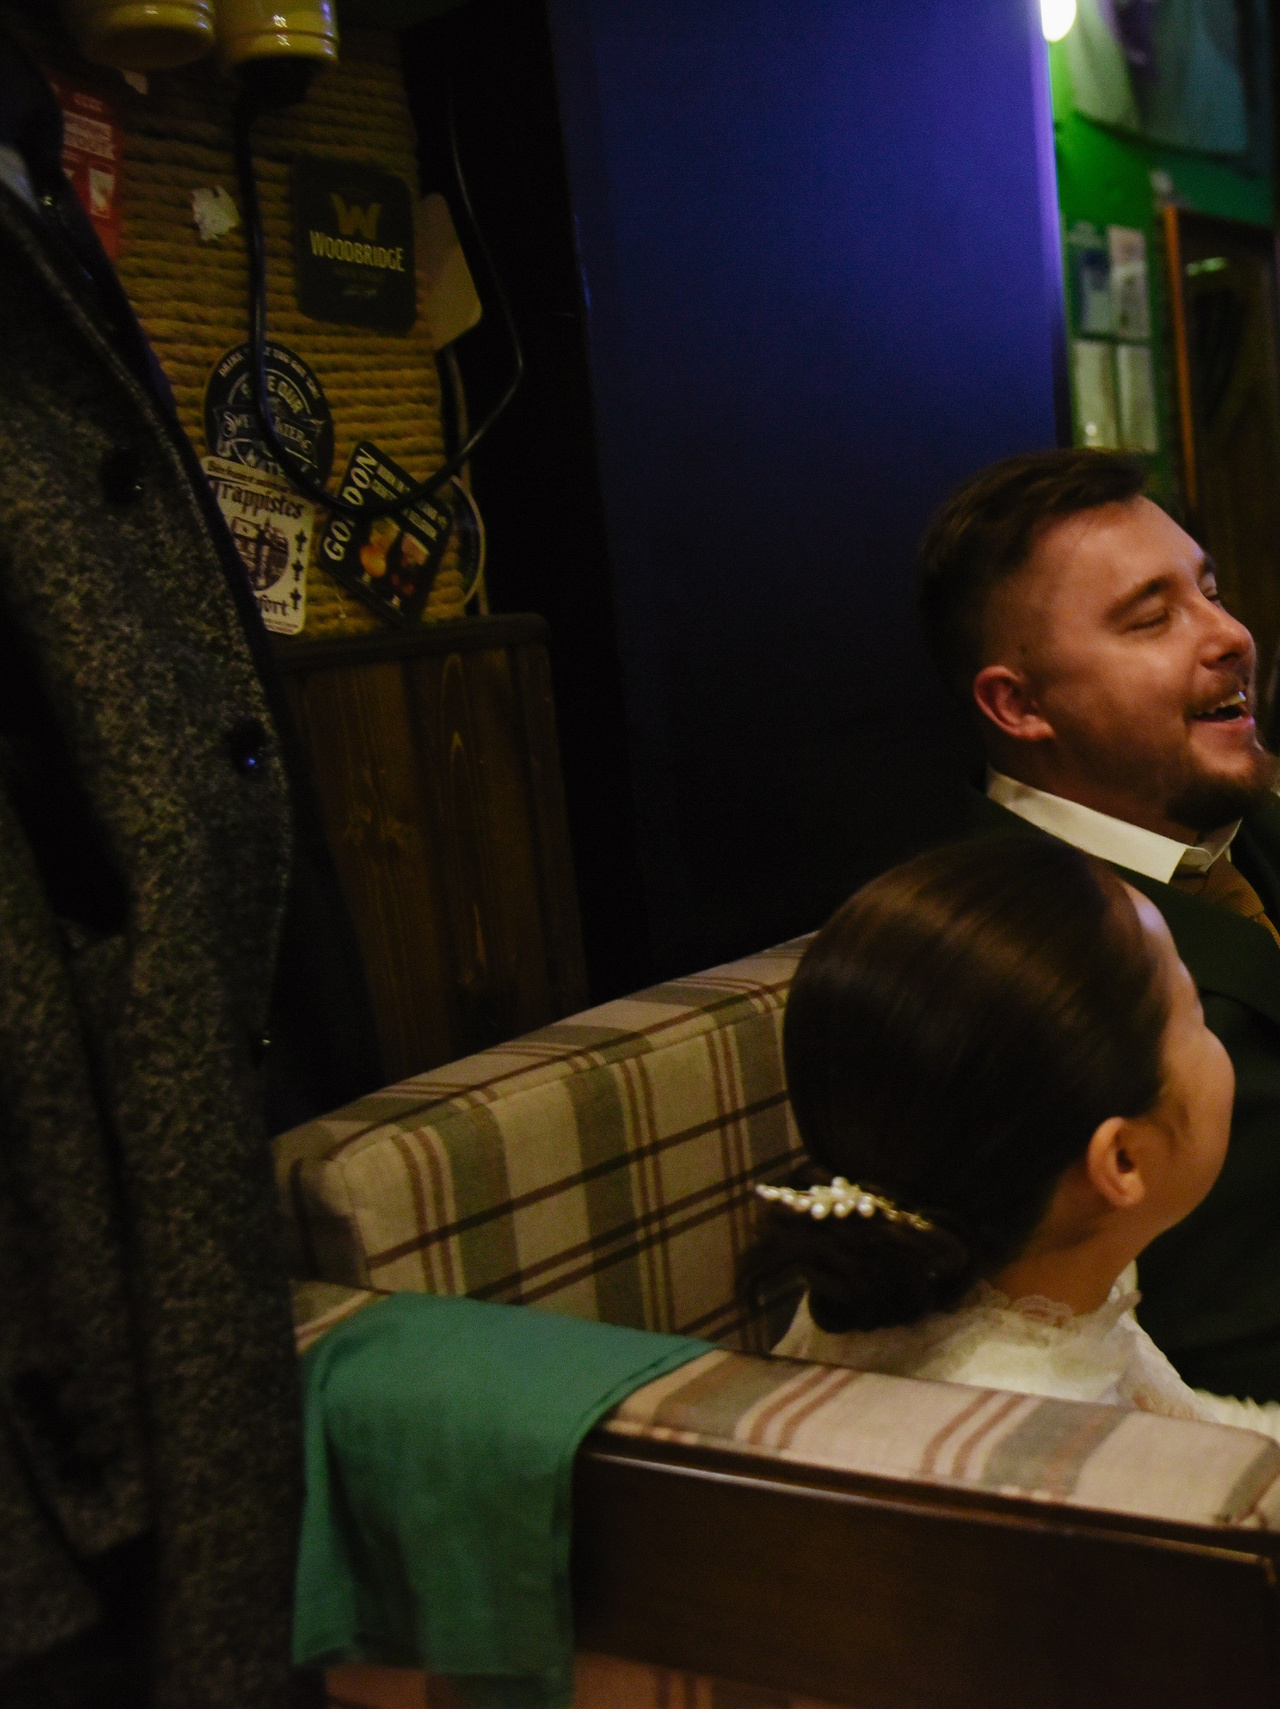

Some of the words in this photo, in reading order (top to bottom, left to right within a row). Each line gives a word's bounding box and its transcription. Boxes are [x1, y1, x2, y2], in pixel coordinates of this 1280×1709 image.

[329, 193, 381, 240] W
[309, 230, 406, 272] WOODBRIDGE
[322, 446, 380, 562] GODON
